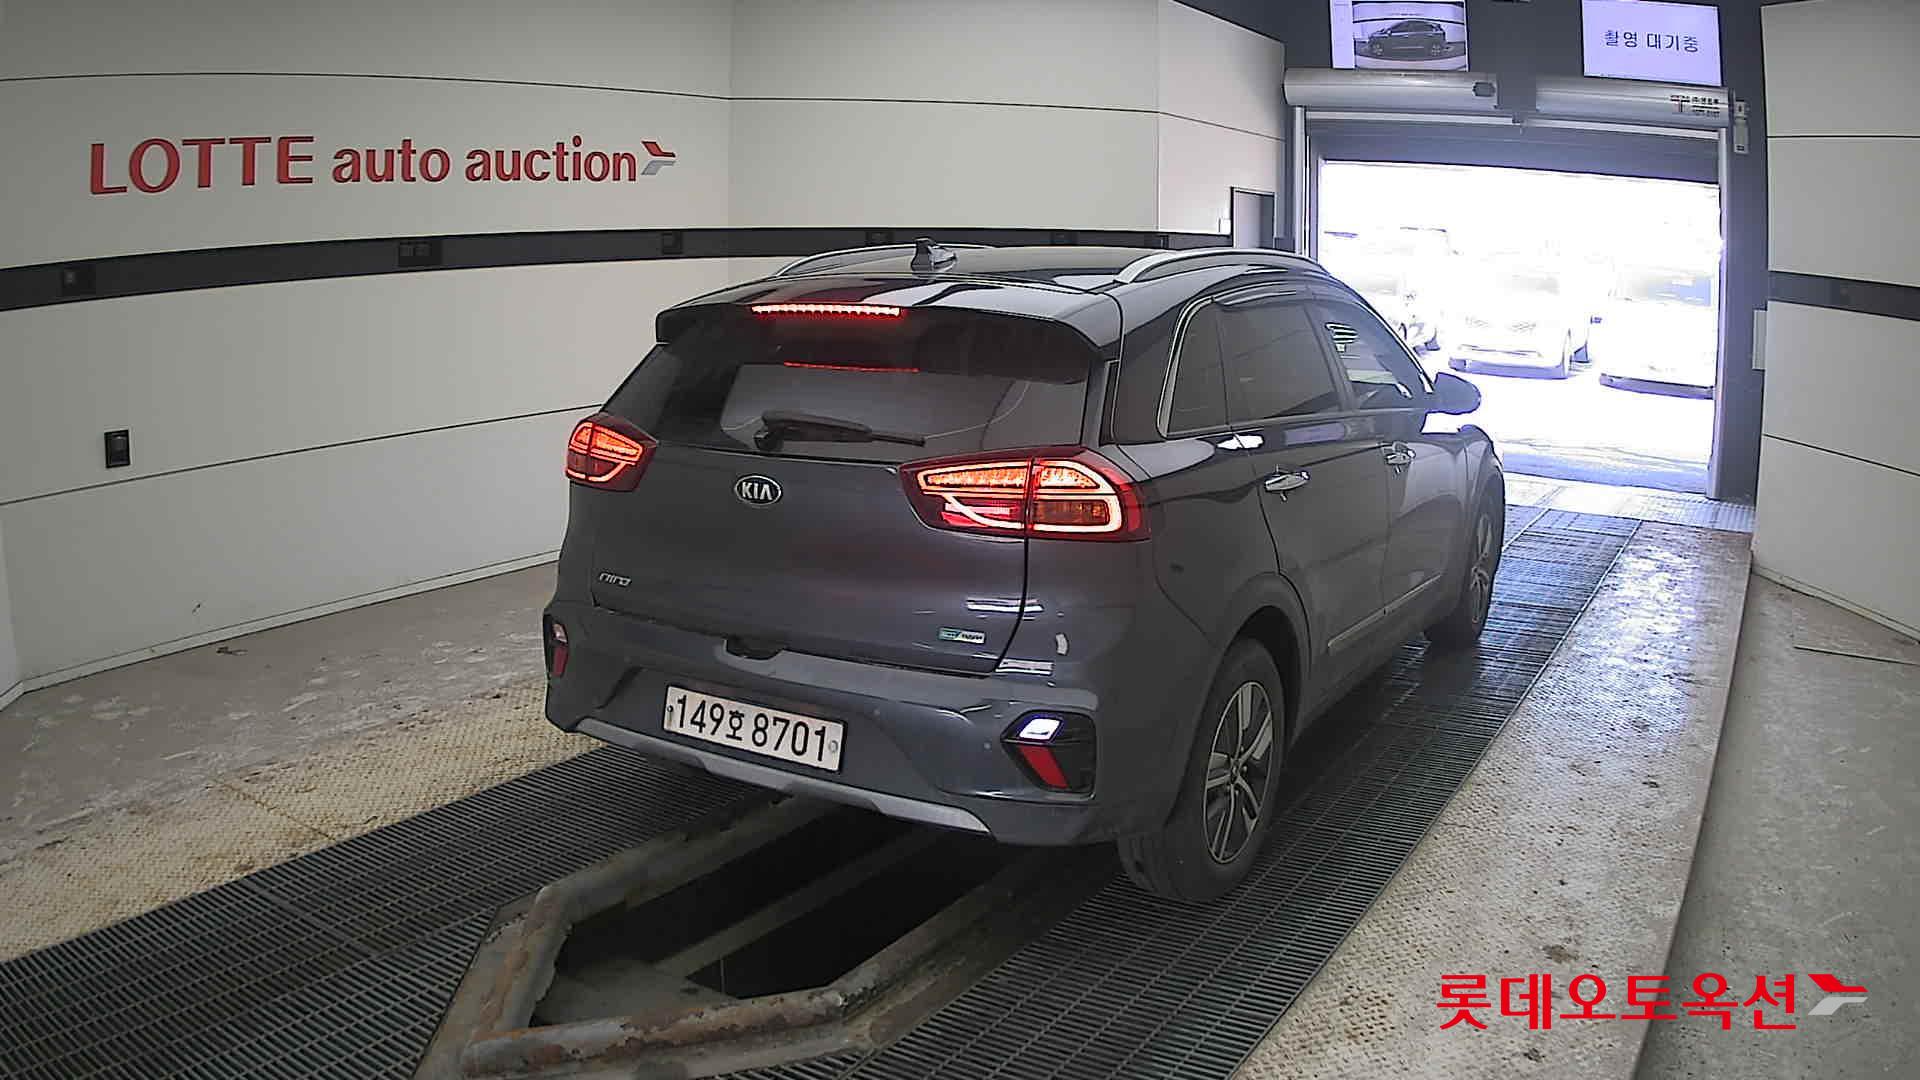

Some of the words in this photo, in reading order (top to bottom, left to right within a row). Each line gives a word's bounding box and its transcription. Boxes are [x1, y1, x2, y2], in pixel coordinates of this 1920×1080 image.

[1604, 30, 1638, 48] 촬영
[1646, 33, 1698, 53] 대기중
[90, 136, 315, 195] LOTTE
[332, 138, 450, 183] auto
[464, 135, 638, 183] auction
[742, 481, 773, 501] KIA
